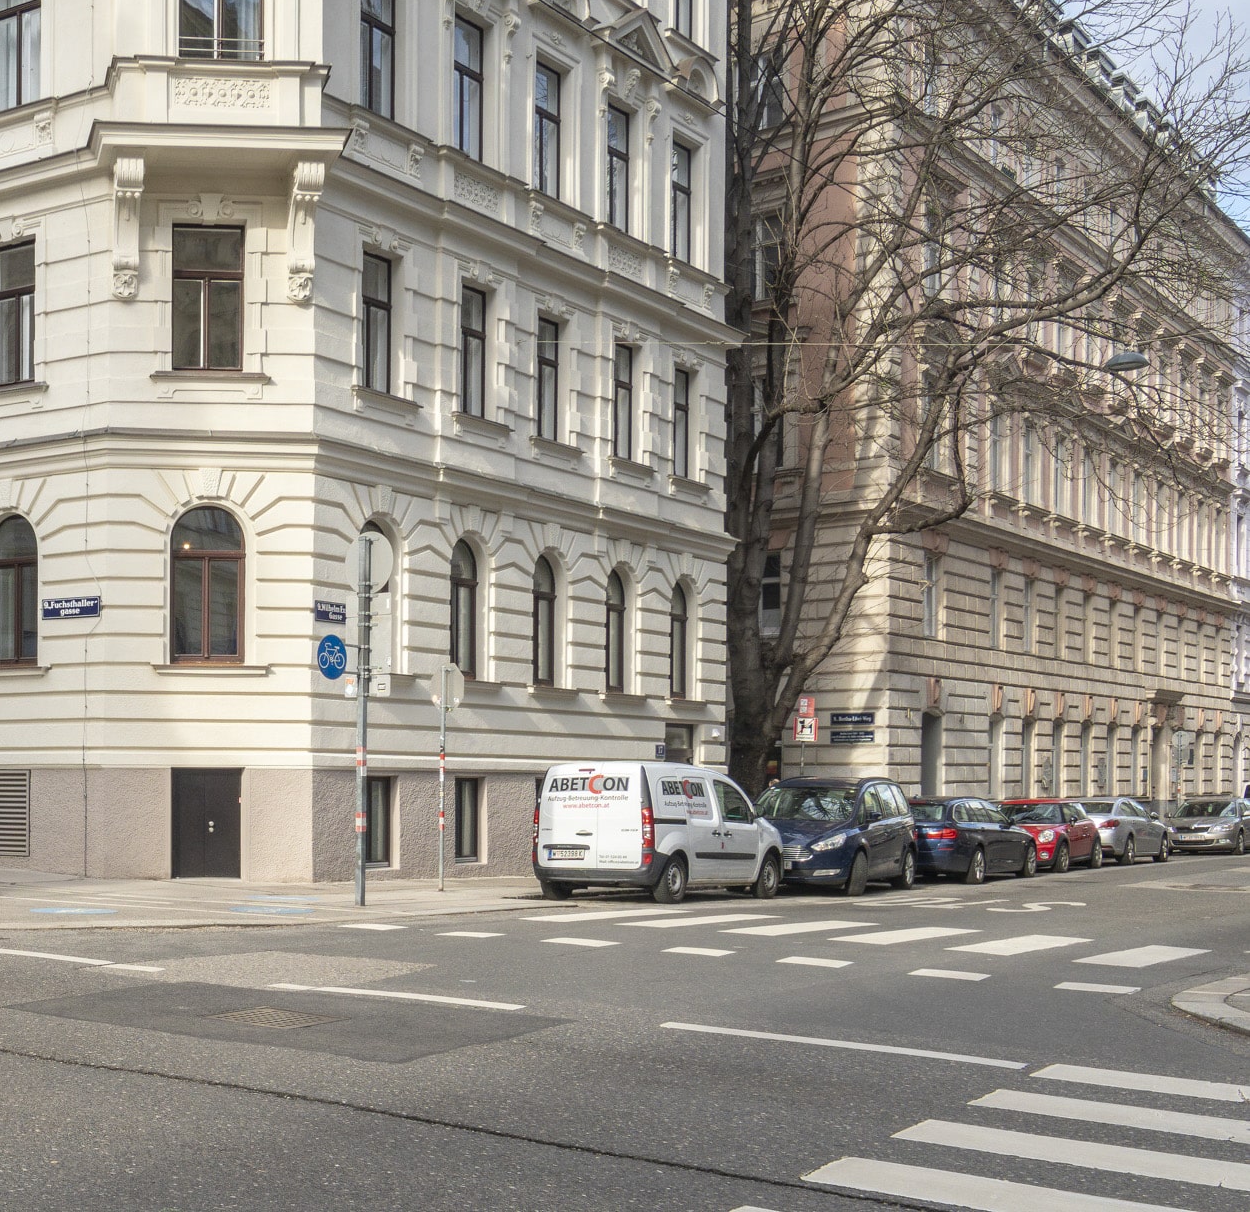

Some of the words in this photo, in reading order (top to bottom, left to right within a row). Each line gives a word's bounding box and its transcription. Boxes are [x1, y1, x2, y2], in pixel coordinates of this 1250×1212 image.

[60, 608, 80, 617] gasse
[549, 774, 630, 794] ABETCON
[661, 779, 705, 799] ABETCON
